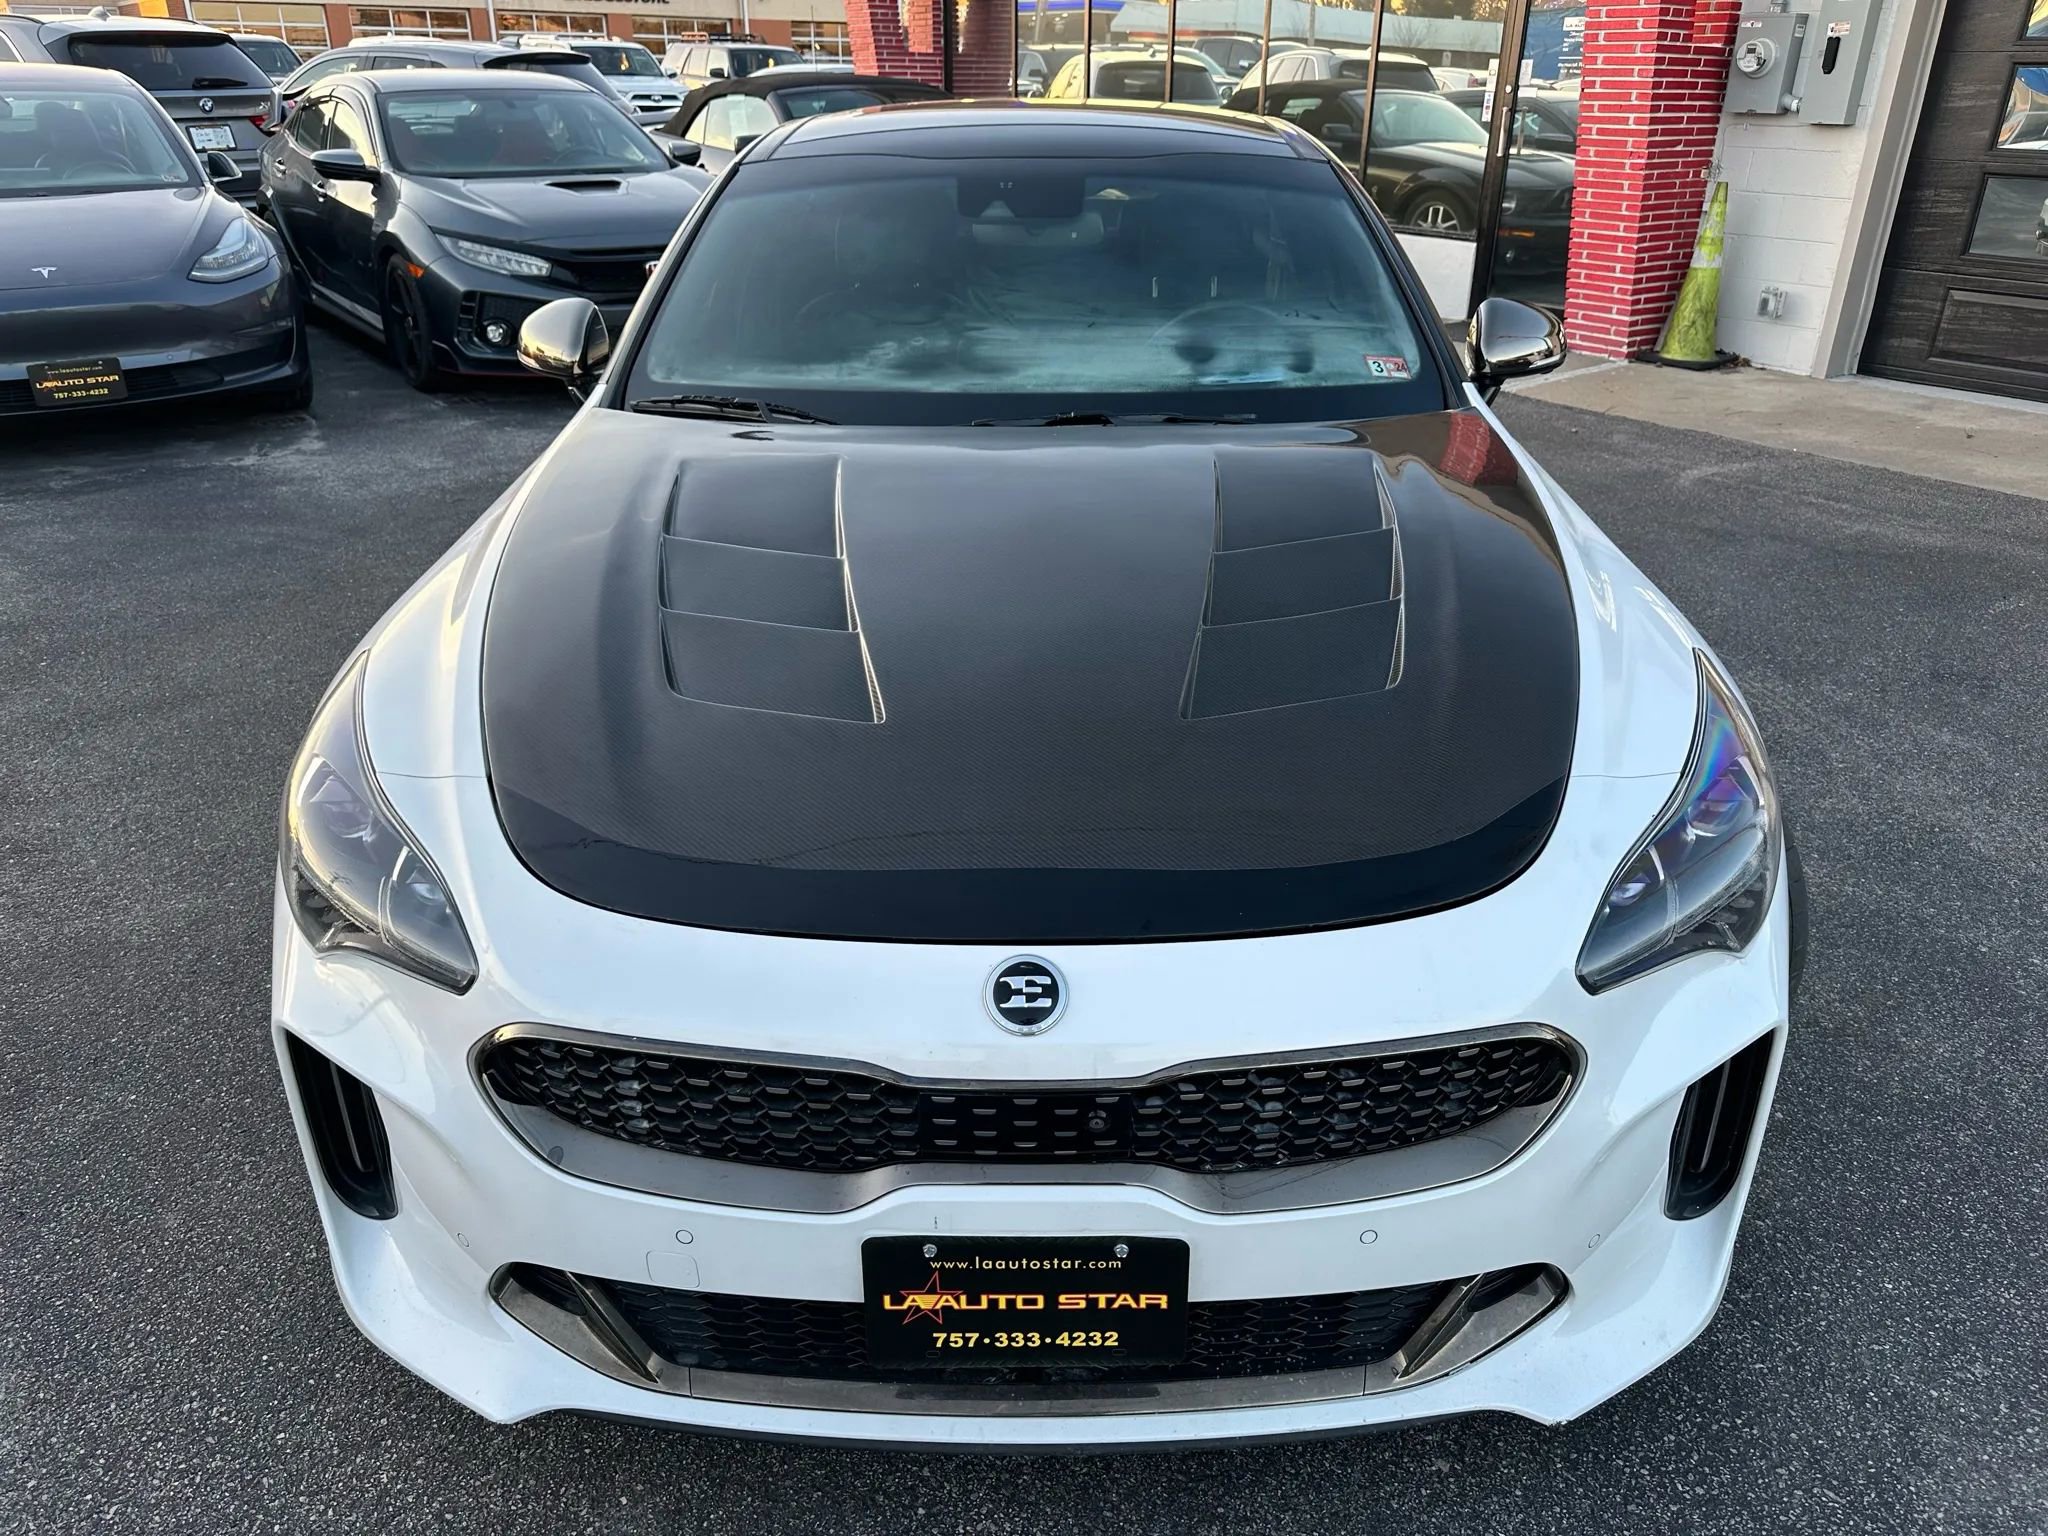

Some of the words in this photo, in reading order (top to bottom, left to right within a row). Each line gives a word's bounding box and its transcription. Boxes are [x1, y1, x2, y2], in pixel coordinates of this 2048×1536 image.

[1372, 361, 1384, 373] 3
[1394, 362, 1407, 372] 24
[86, 374, 119, 384] STAR
[929, 1256, 1122, 1270] www.laautostar.com
[1057, 1293, 1169, 1310] STAR
